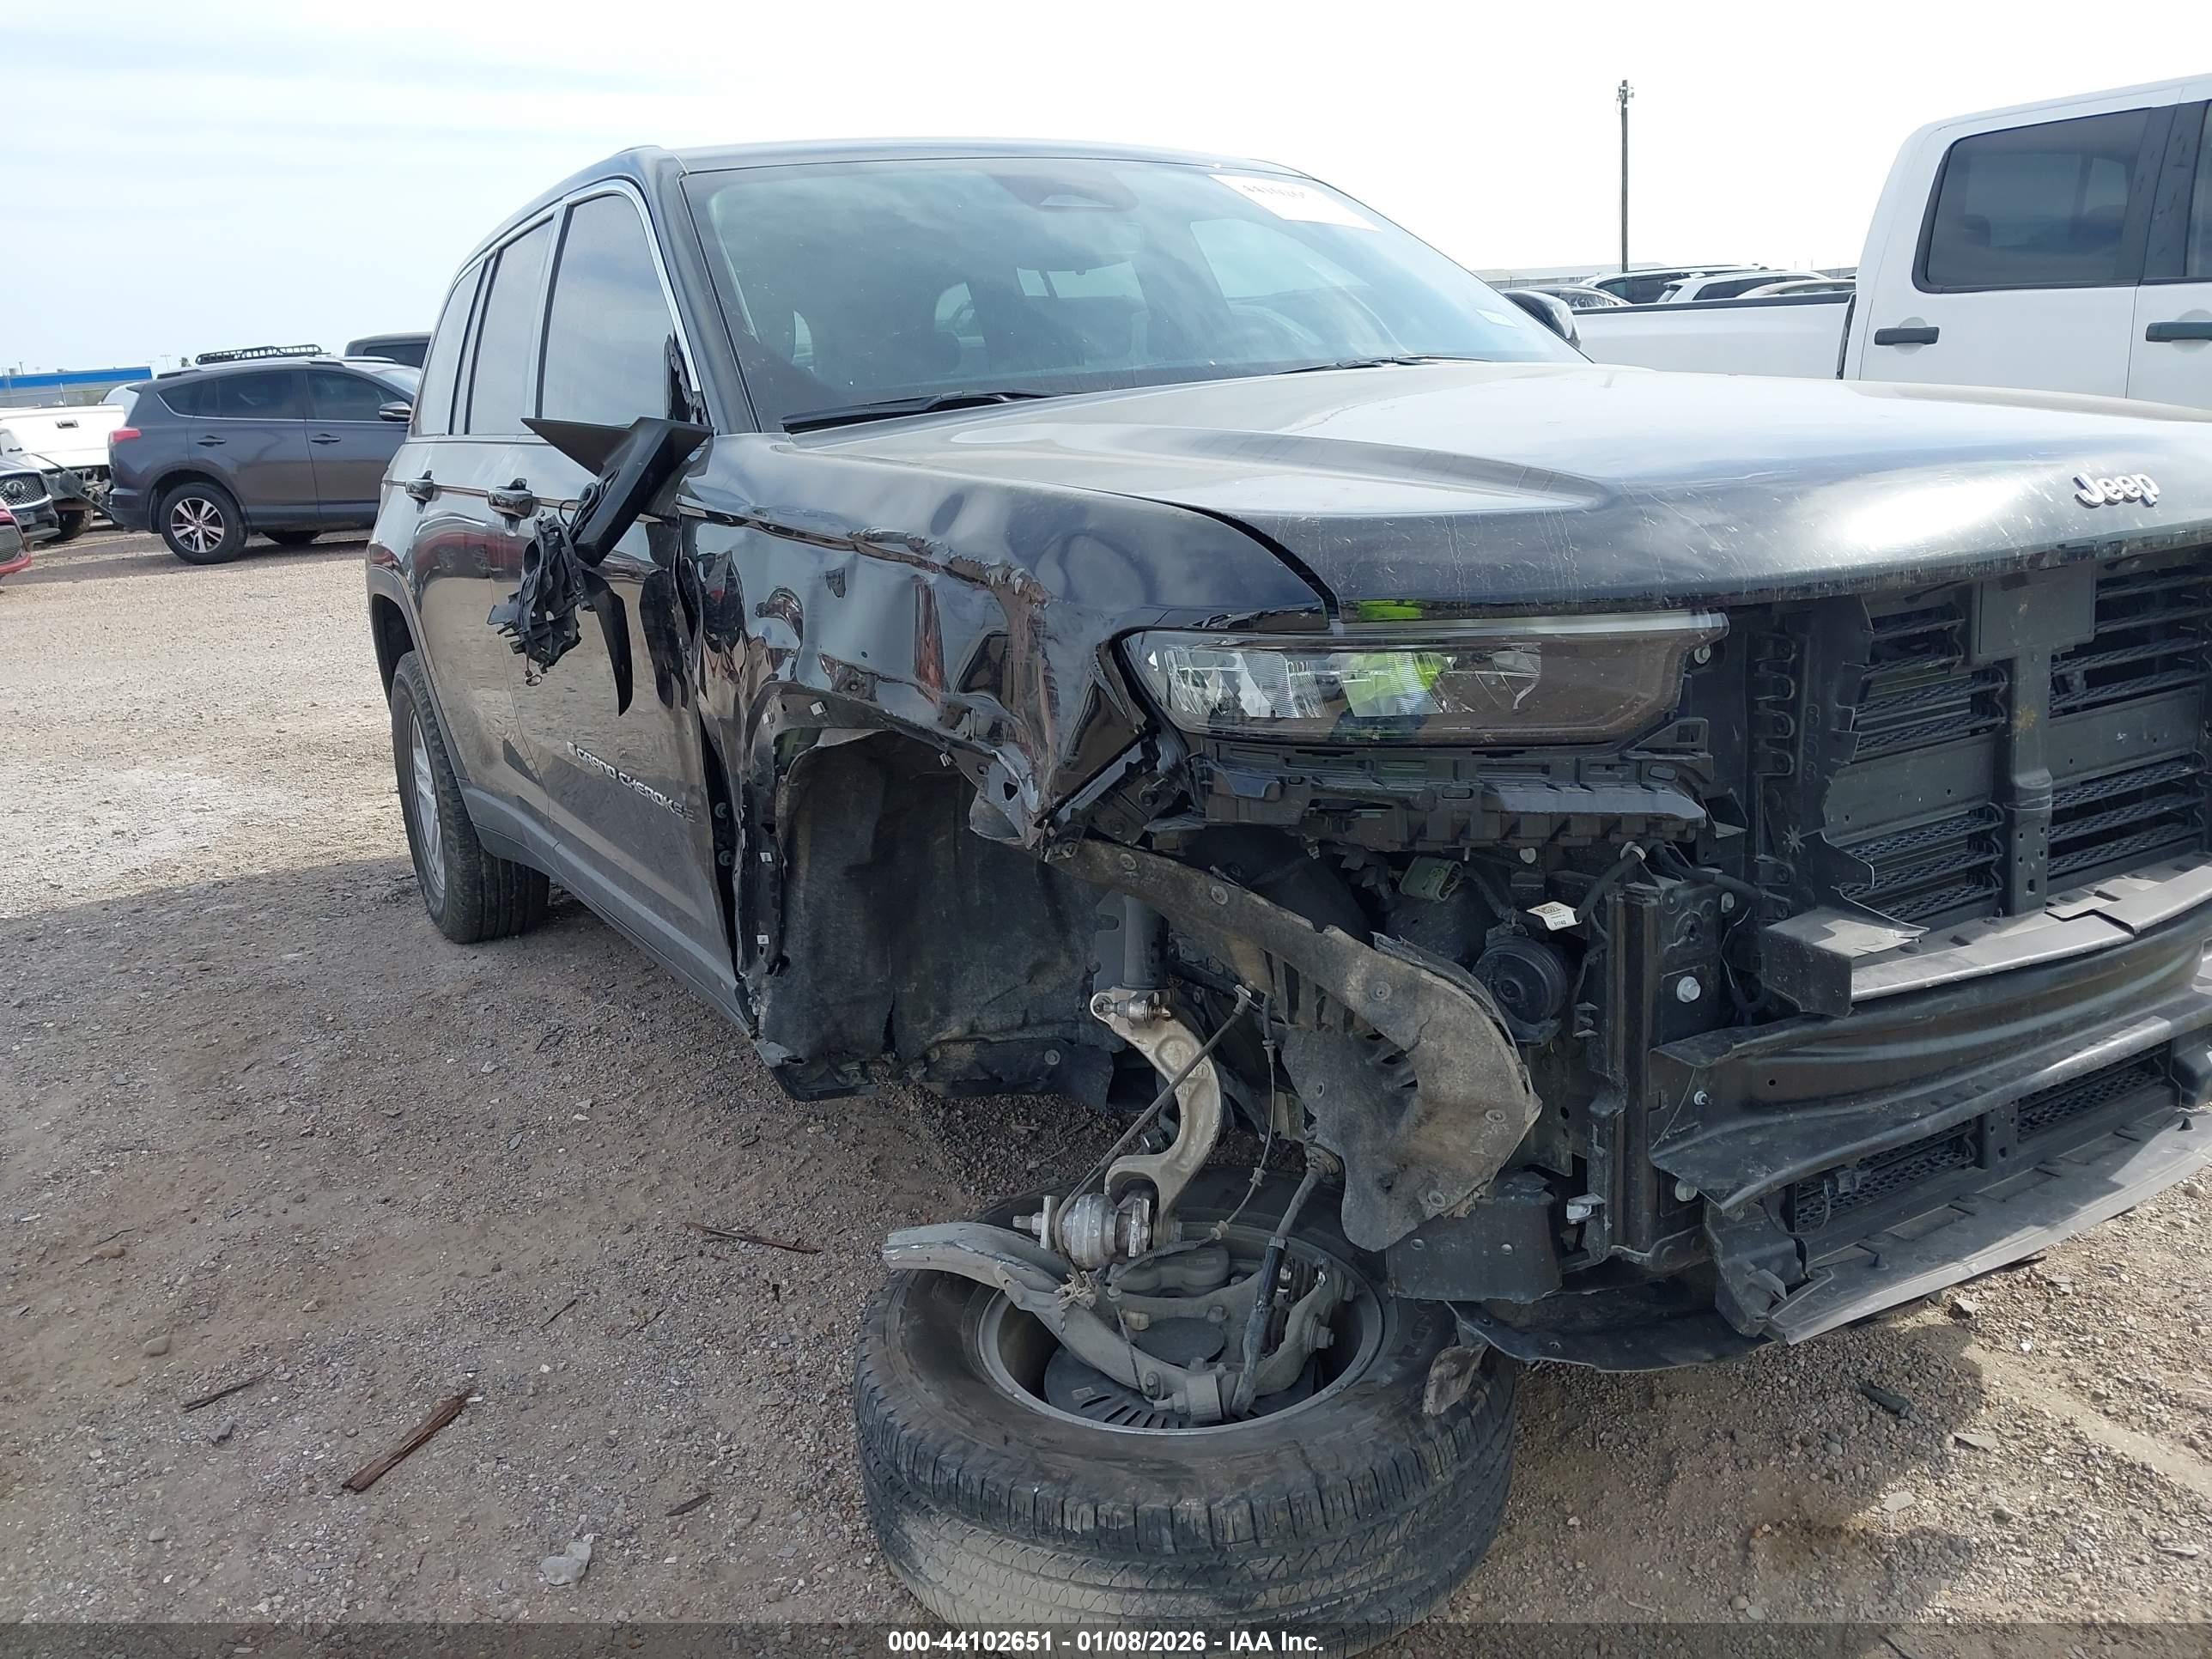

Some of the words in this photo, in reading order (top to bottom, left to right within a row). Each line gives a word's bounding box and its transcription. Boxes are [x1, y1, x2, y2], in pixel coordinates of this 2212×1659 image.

[2072, 472, 2160, 509] Jeep
[575, 748, 618, 780] GRAND
[618, 771, 696, 823] CHEROKEE
